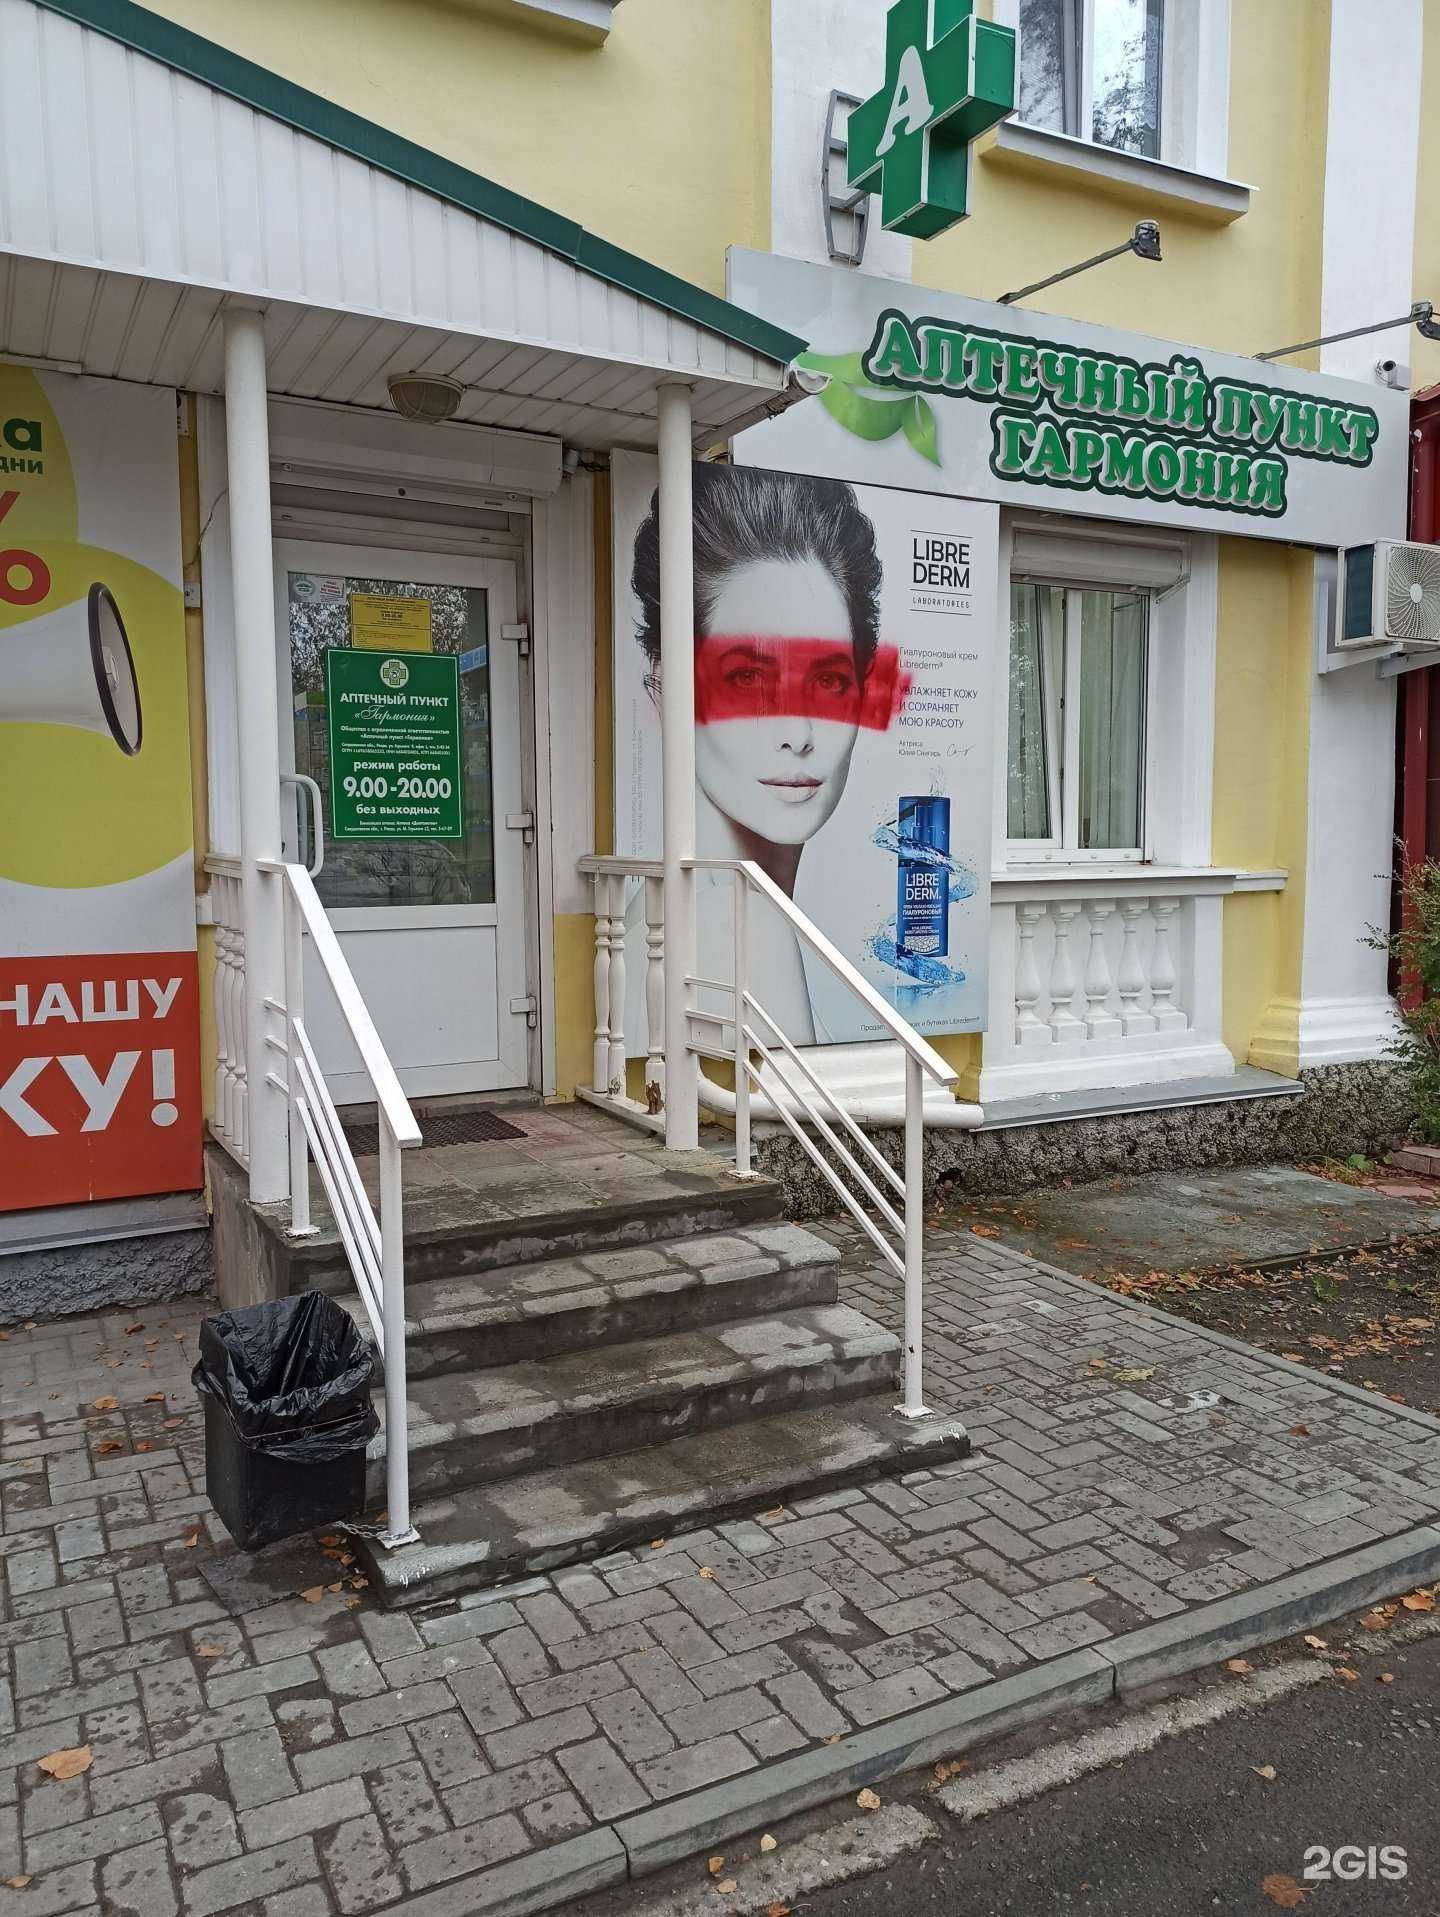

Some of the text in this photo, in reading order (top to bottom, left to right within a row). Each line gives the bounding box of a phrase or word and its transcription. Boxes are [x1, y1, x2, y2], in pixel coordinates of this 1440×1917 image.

[869, 314, 1378, 463] АПТЕЧНЫЙ ПУНКТ
[0, 417, 43, 453] а
[995, 413, 1285, 513] ГАРМОНИЯ
[912, 537, 971, 565] LIBRE
[912, 562, 971, 589] DERM
[912, 596, 971, 609] LABORATORIES
[958, 652, 978, 662] крем
[340, 692, 449, 707] АПТЕЧНЫЙ ПУНКТ
[953, 688, 978, 699] КОЖУ
[899, 701, 959, 713] И СОХРАНЯЕТ
[898, 716, 965, 729] МОЮ КРАСОТУ
[353, 759, 441, 773] режим работы
[356, 803, 441, 815] без выходных
[905, 873, 940, 887] LIBRE
[0, 977, 183, 1027] НАШУ
